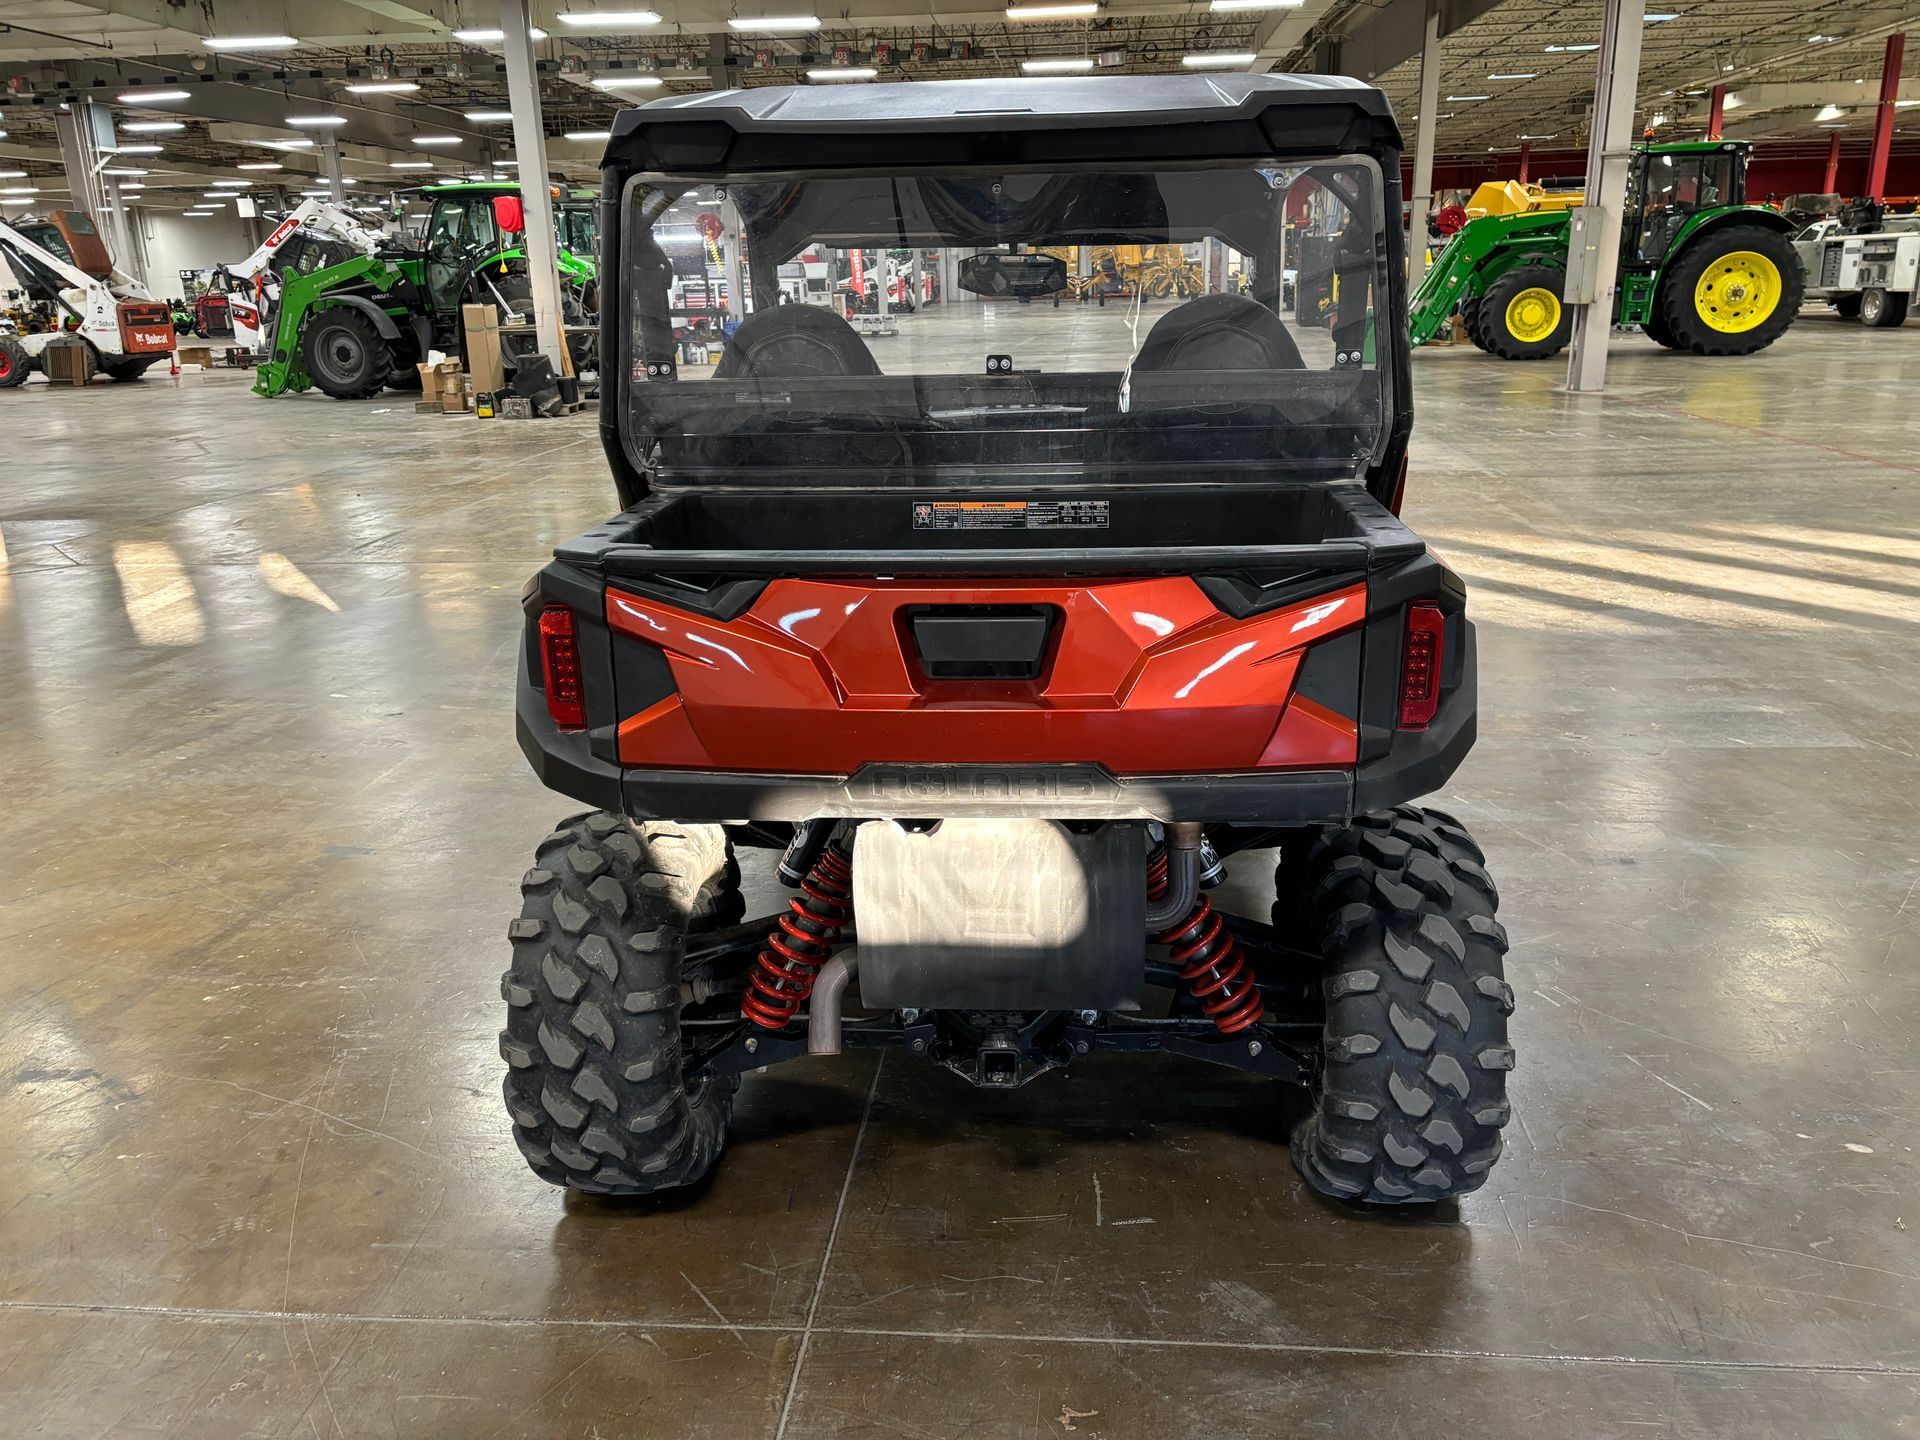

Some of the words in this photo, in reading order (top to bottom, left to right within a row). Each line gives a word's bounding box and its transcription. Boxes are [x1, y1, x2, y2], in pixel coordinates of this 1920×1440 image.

[757, 54, 767, 63] 99
[835, 51, 847, 60] 103
[641, 57, 650, 66] 93
[680, 57, 690, 66] 95
[278, 223, 295, 240] Bobcat
[97, 306, 104, 314] 2
[145, 333, 168, 344] Bobcat
[872, 771, 1095, 797] POLARIS
